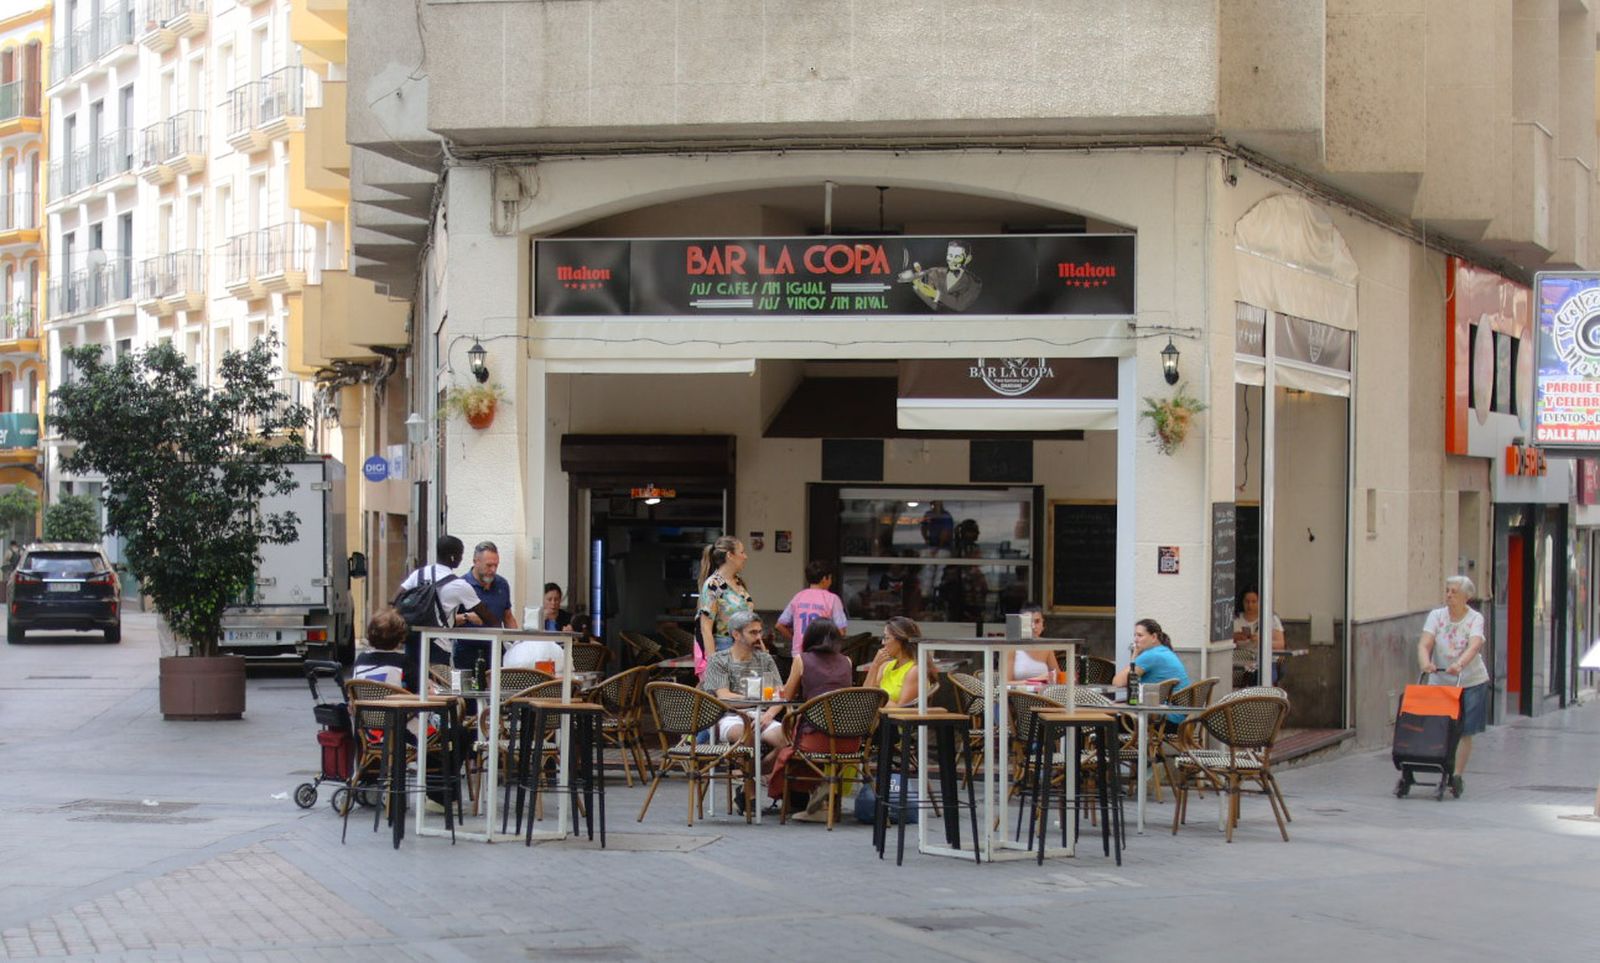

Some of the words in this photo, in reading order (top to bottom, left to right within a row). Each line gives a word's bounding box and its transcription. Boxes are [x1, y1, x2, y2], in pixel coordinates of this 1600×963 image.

[686, 244, 748, 275] BAR
[758, 244, 795, 275] LA
[803, 243, 891, 275] COPA
[556, 265, 612, 281] Mahou
[1057, 261, 1118, 278] Mahou
[690, 281, 712, 296] SUS
[761, 281, 781, 296] SIN
[785, 281, 826, 296] IGUAL
[758, 296, 780, 311] SUS
[786, 296, 827, 311] VINOS
[830, 296, 852, 311] SIN
[855, 296, 889, 310] RIVAL
[969, 366, 997, 378] BAR
[1000, 366, 1018, 378] LA
[1020, 366, 1054, 378] COPA
[1546, 382, 1594, 394] PARQUE
[1545, 396, 1554, 407] Y
[1543, 413, 1586, 422] EVENTOS
[1537, 429, 1576, 441] CALLE
[365, 463, 386, 473] DIGI
